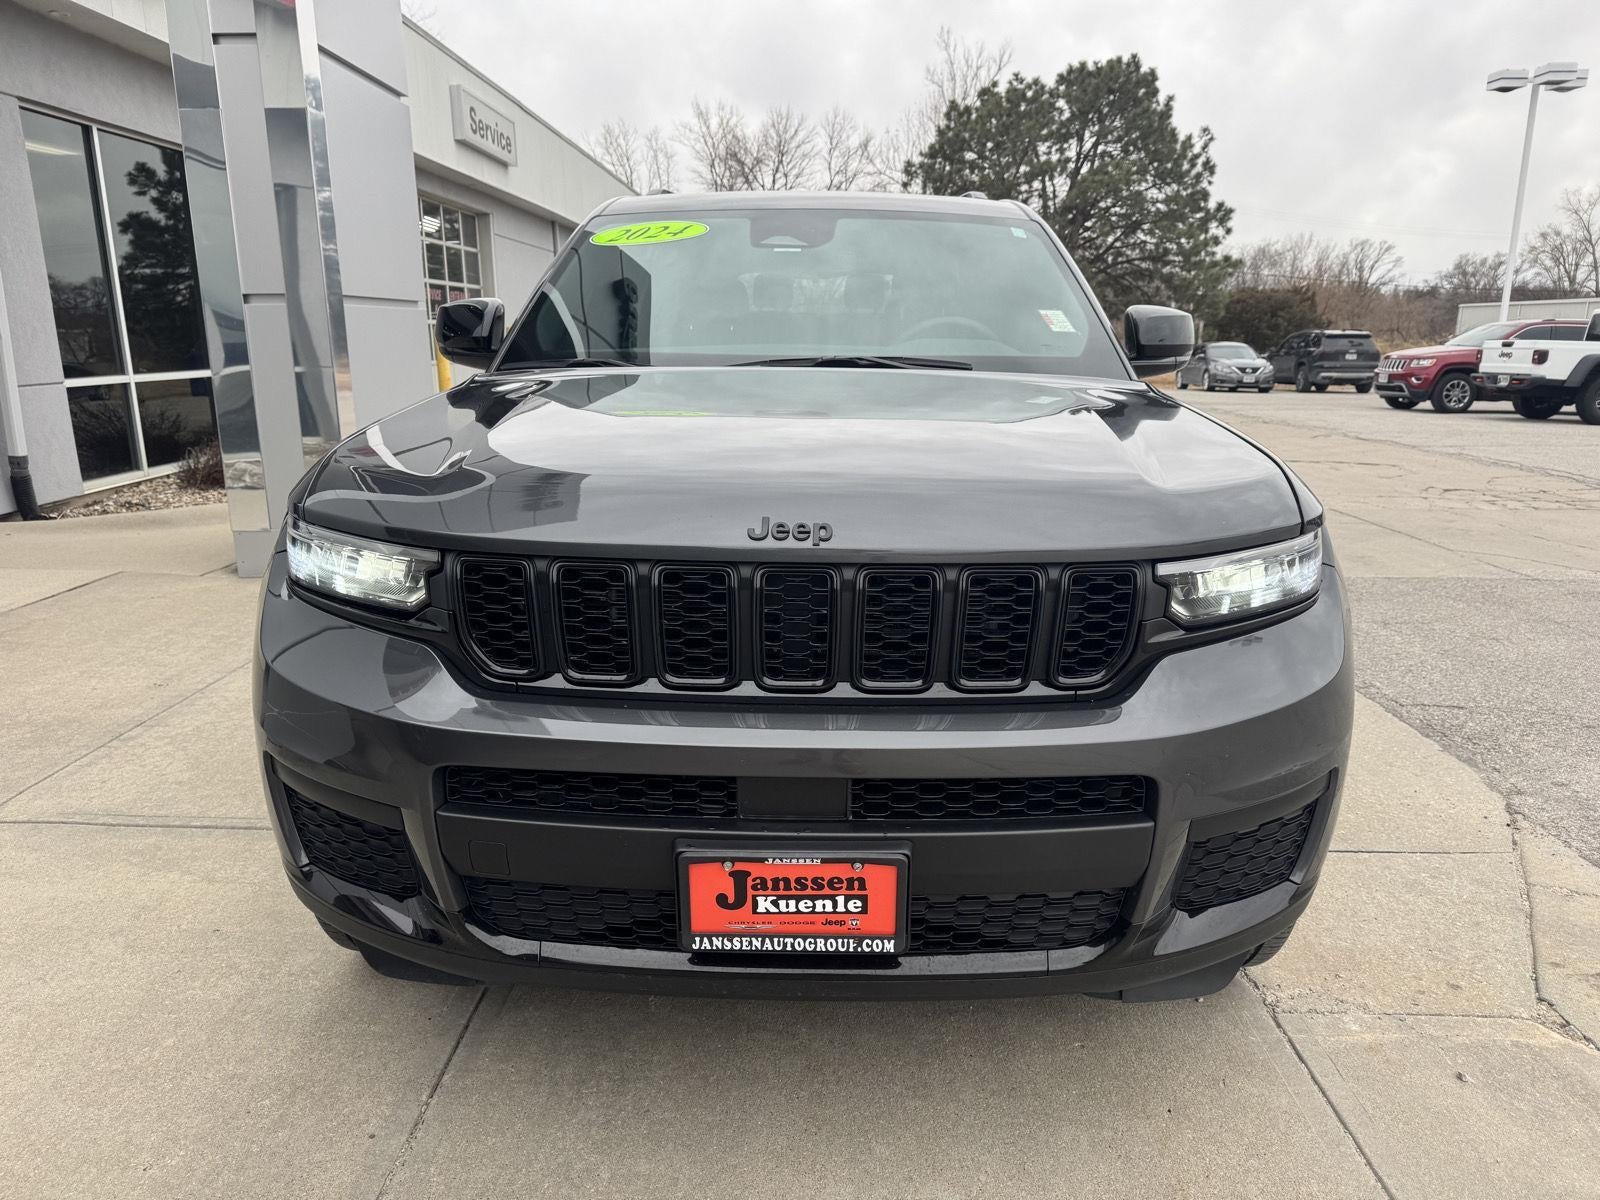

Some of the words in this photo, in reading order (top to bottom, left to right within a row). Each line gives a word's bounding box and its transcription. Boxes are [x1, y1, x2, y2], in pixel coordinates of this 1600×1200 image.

[469, 106, 512, 154] Service
[605, 224, 694, 243] 2024
[1498, 350, 1513, 360] Jeep
[746, 516, 834, 547] Jeep
[764, 857, 822, 865] JANSSEN
[715, 869, 868, 911] Janssen
[755, 895, 863, 913] Kuenle
[821, 918, 847, 928] Jeep
[692, 936, 895, 953] JANSSENAUTOGROUP.COM
